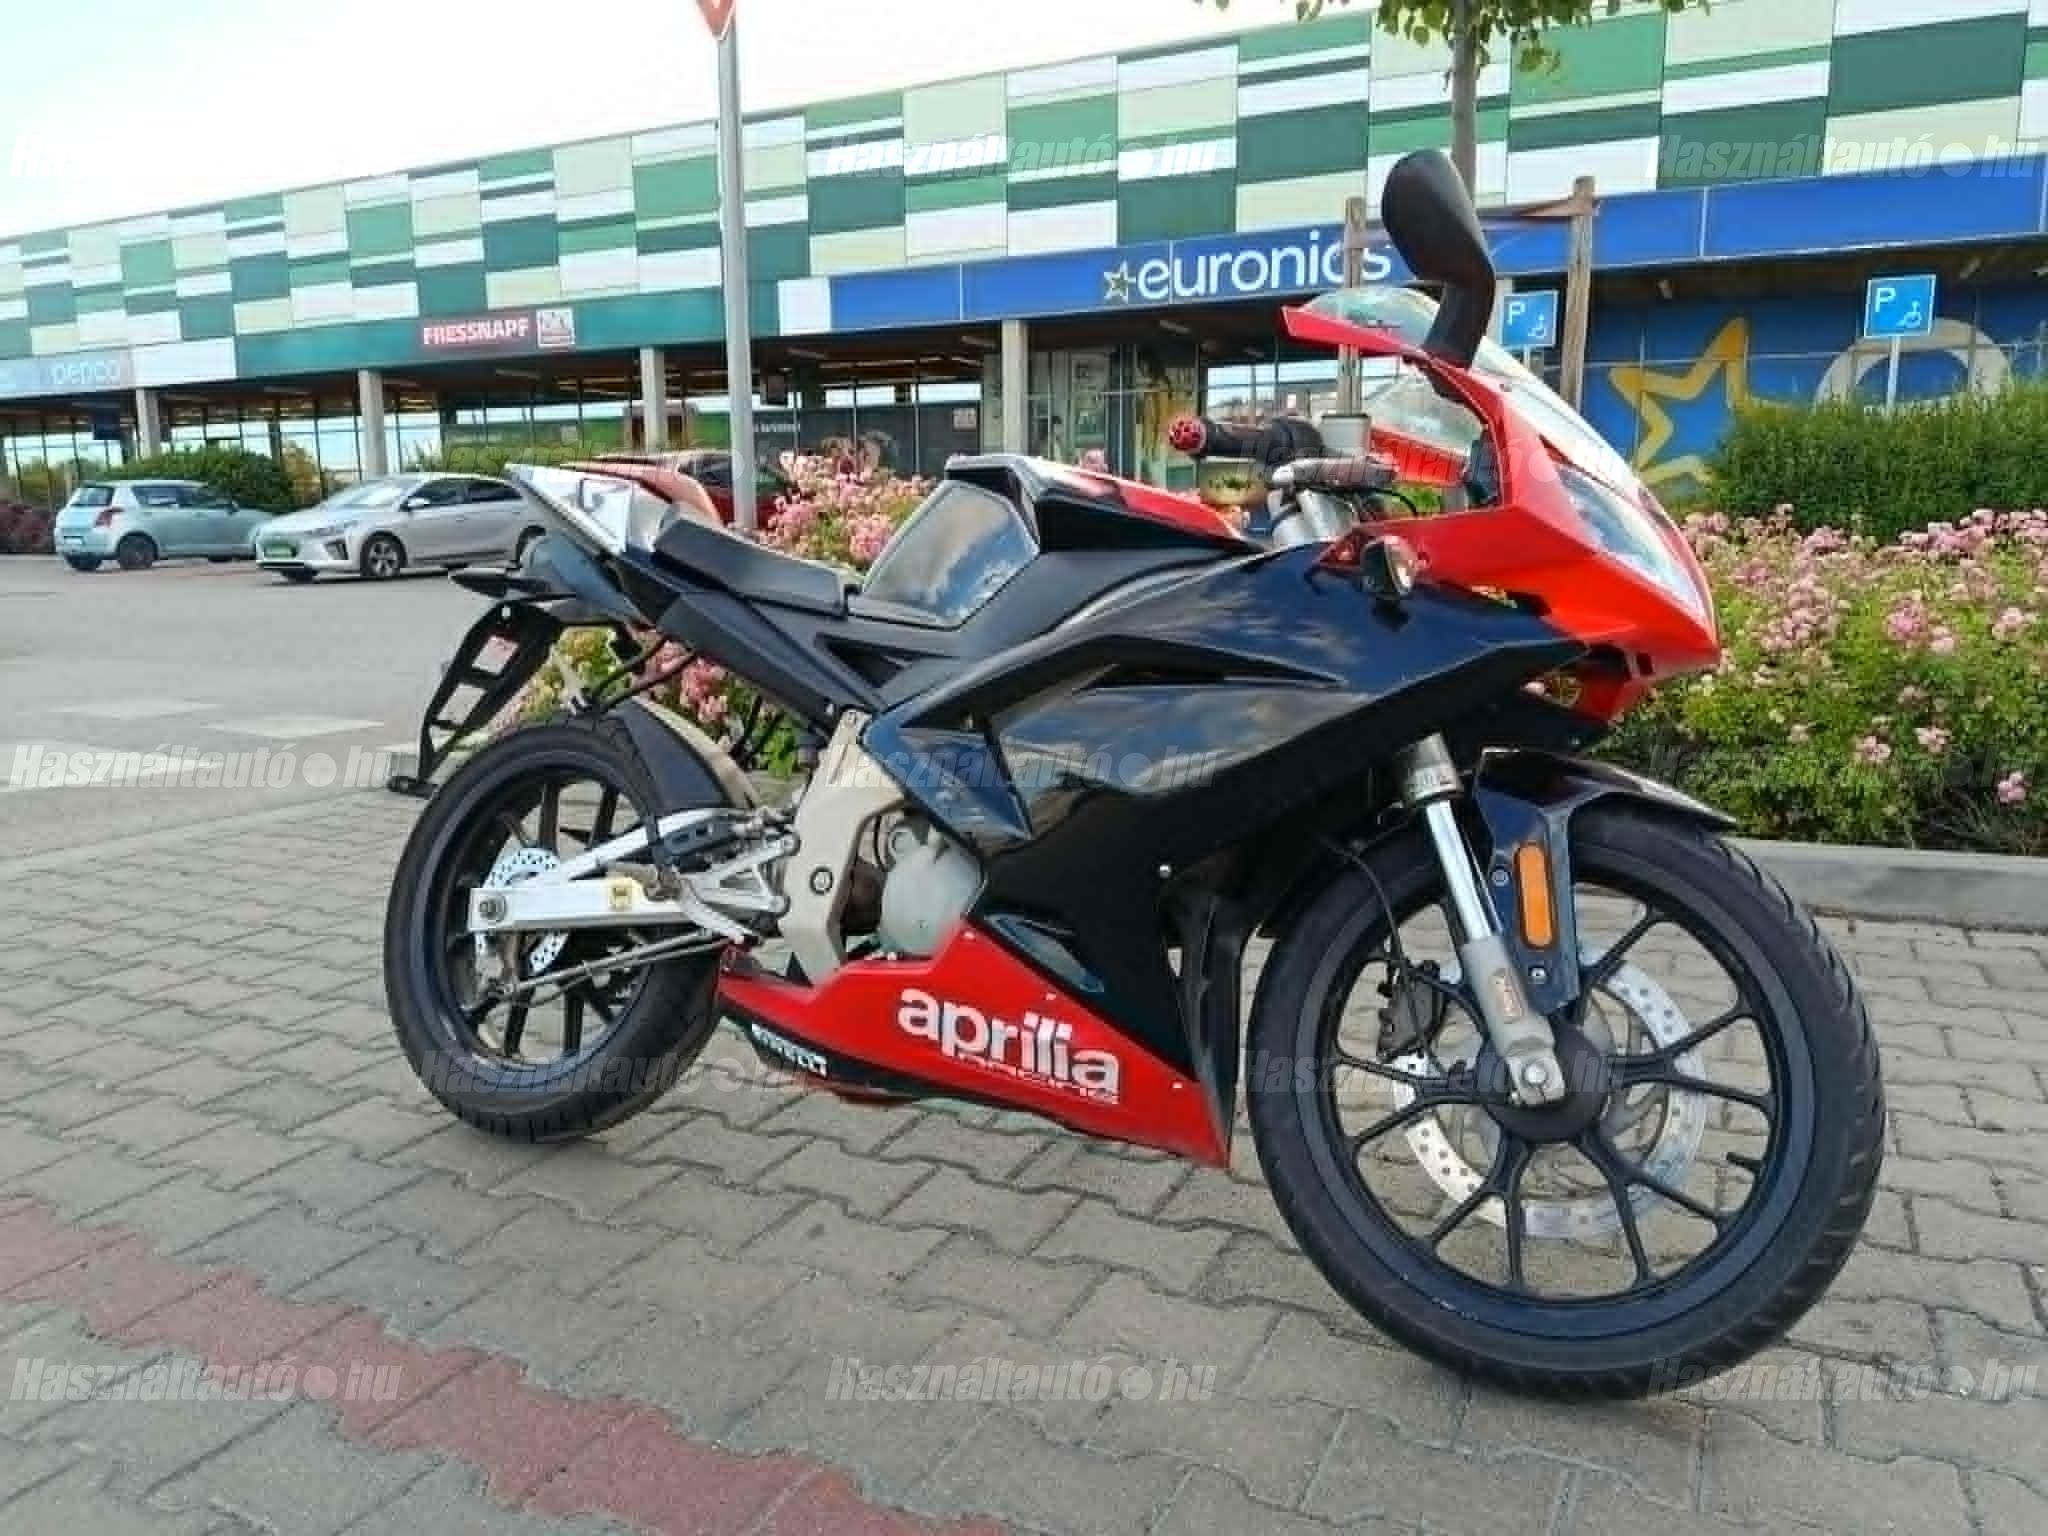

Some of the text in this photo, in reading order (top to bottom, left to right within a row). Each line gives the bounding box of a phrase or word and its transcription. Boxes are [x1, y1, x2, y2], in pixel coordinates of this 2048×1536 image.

[1137, 230, 1391, 299] euronics
[1507, 301, 1526, 325] P
[1874, 287, 1897, 313] P
[423, 317, 529, 346] FRESSNAPF
[898, 987, 1119, 1096] aprilia
